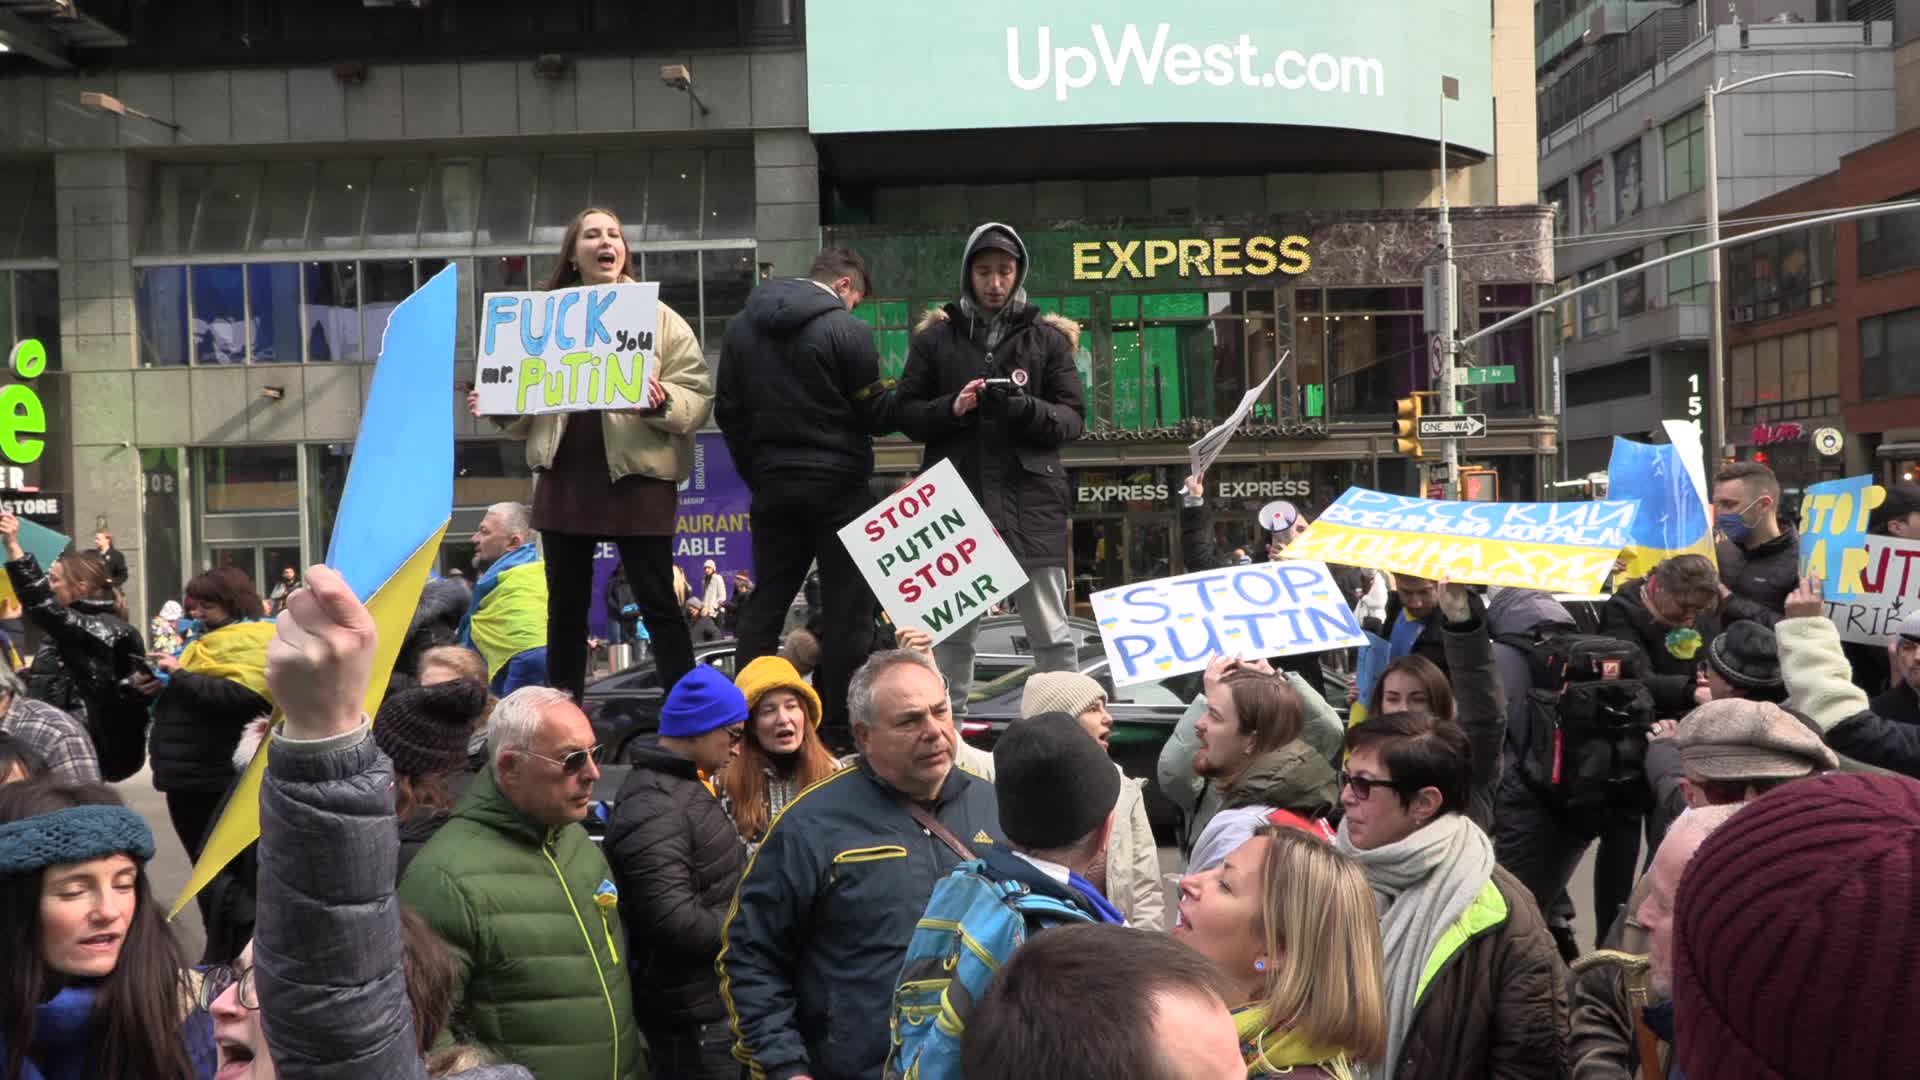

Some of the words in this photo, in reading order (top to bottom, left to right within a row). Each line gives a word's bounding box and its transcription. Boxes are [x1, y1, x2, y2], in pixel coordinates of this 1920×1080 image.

[1006, 23, 1385, 102] UpWest.com
[1072, 235, 1312, 280] EXPRESS
[484, 290, 617, 356] FUCK
[1480, 368, 1487, 382] 7
[1423, 423, 1443, 432] ONE
[1455, 421, 1477, 431] WAY
[696, 444, 705, 490] BROADWAY
[1219, 481, 1311, 499] EXPRESS
[0, 498, 58, 515] STORE
[864, 483, 936, 542] STOP
[1078, 484, 1169, 503] EXPRESS
[1347, 490, 1635, 528] РУССКИЙ
[1798, 484, 1887, 535] STOP
[876, 508, 967, 577] PUTIN
[1801, 539, 1869, 593] AR
[898, 537, 977, 603] STOP
[1123, 566, 1323, 625] STOP
[921, 574, 999, 633] WAR
[1113, 603, 1362, 677] PUTIN
